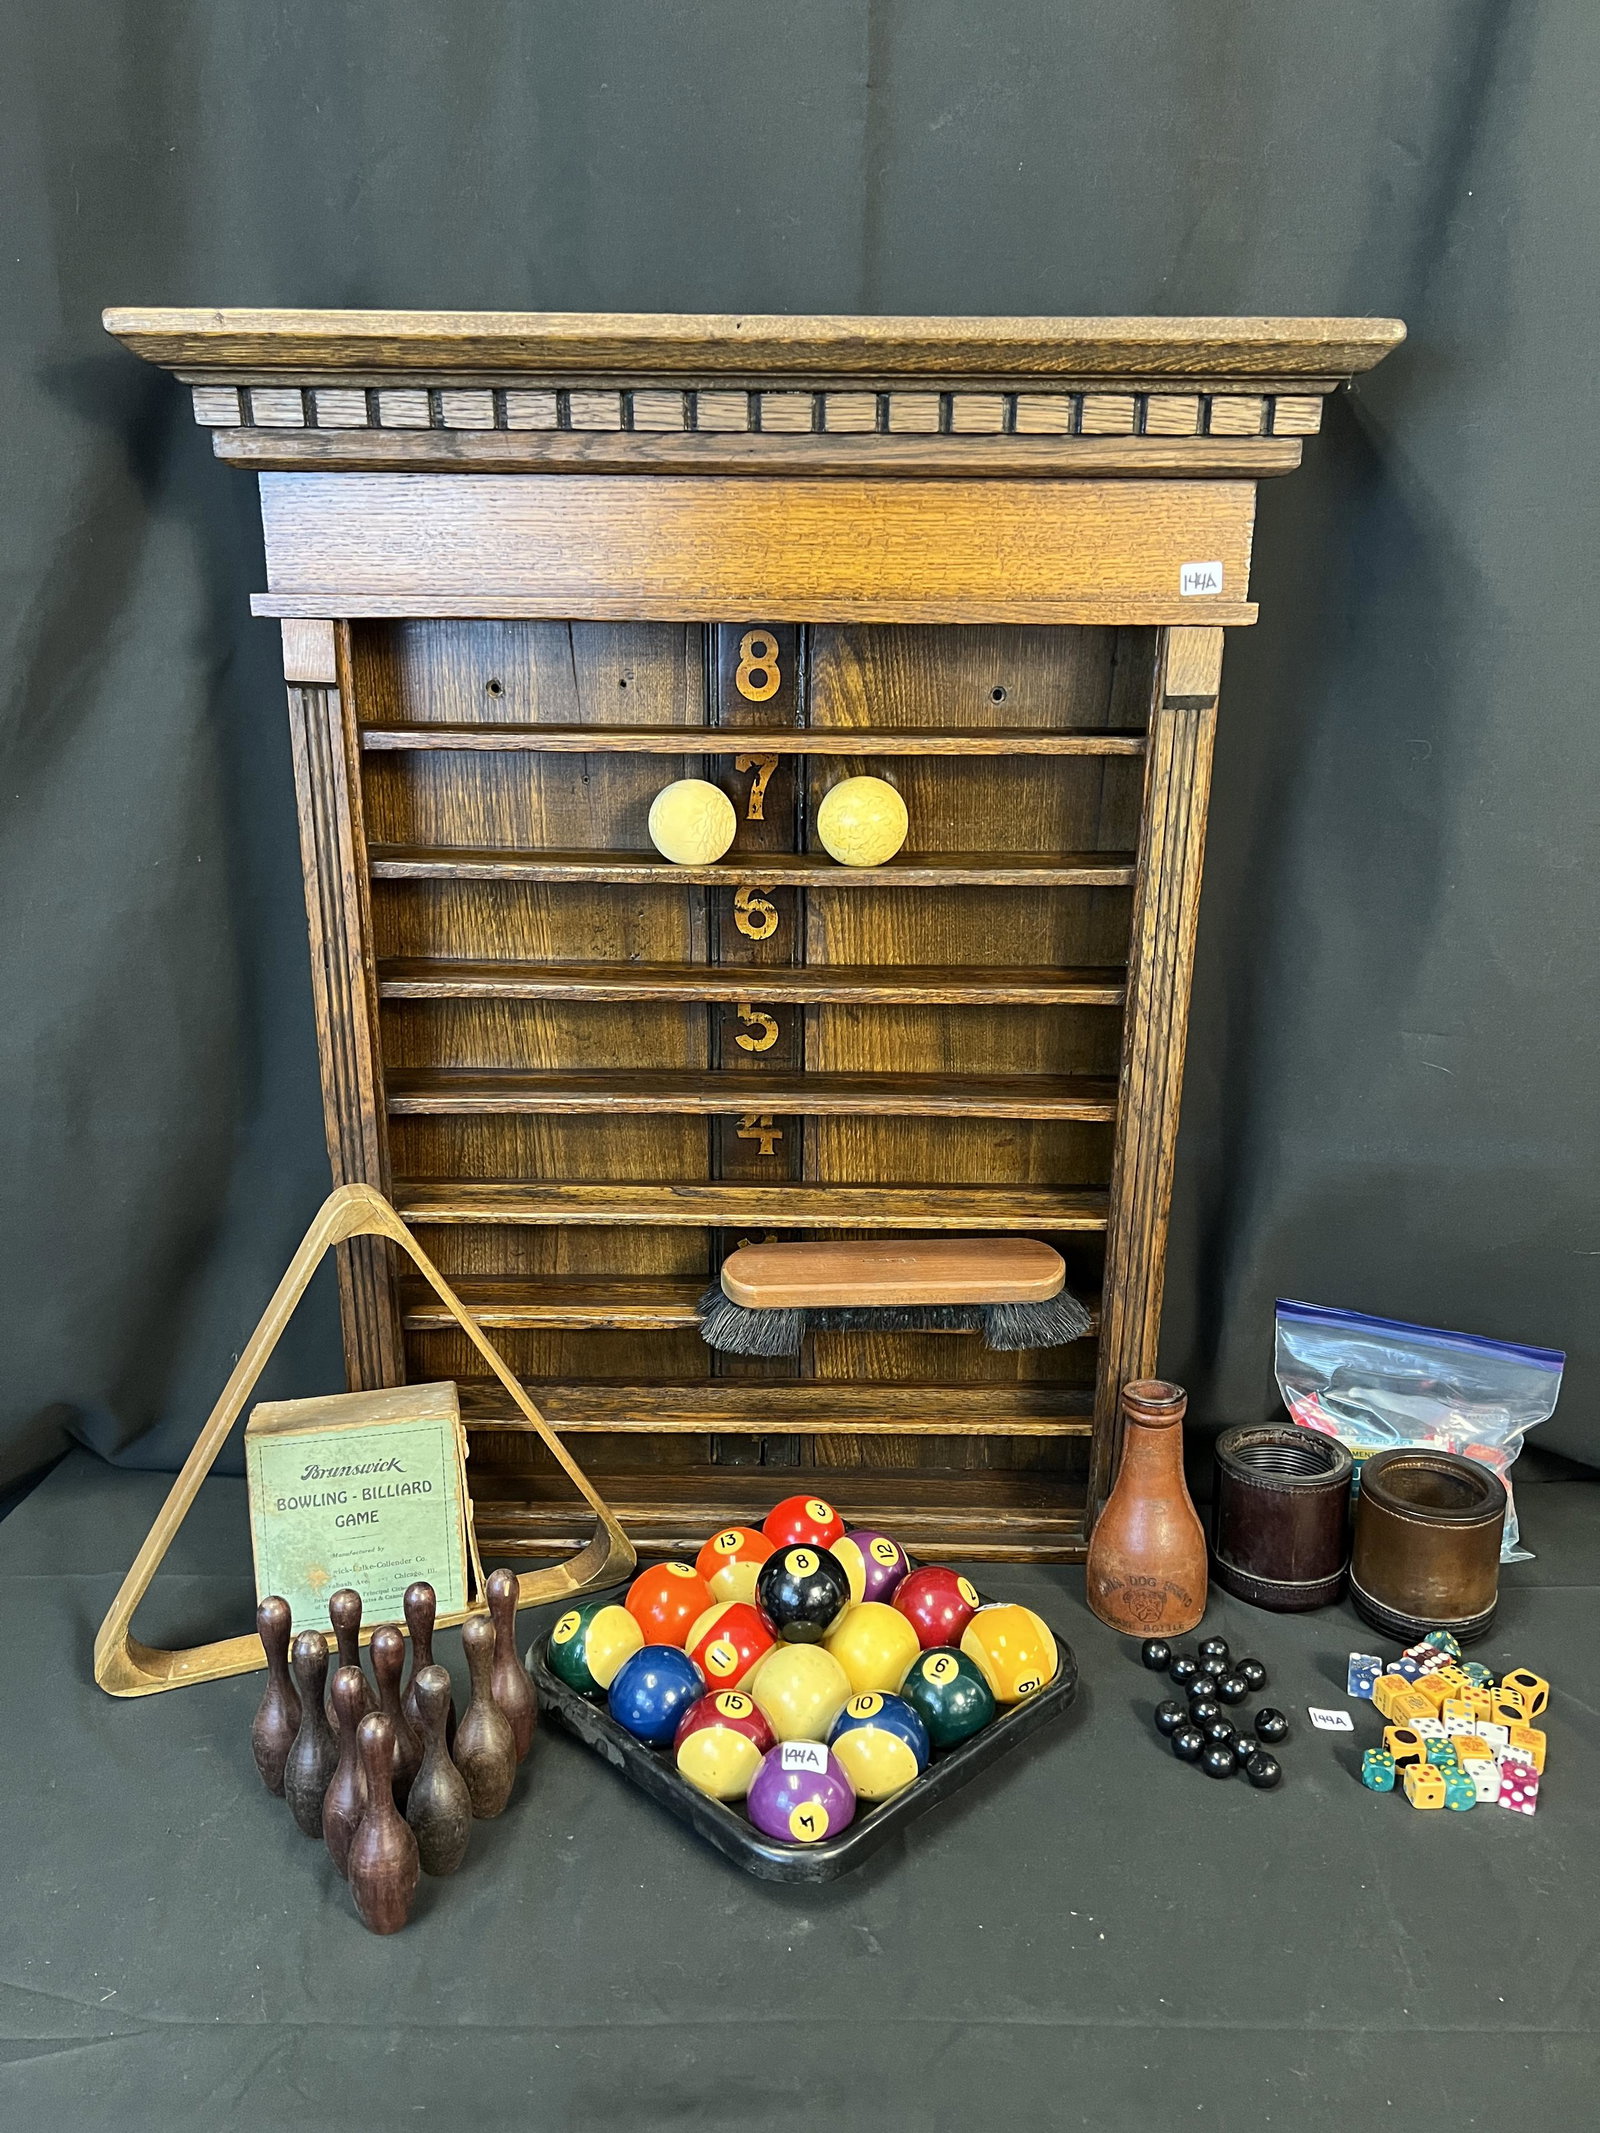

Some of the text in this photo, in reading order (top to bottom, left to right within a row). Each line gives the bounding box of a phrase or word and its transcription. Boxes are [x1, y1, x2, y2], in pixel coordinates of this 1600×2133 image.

[1184, 572, 1217, 592] 144A
[735, 629, 782, 702] 8
[735, 753, 779, 820] 7
[734, 886, 779, 941] 6
[735, 1003, 779, 1051] 5
[735, 1115, 783, 1155] 4
[300, 1457, 407, 1481] Brunswick
[276, 1490, 348, 1511] BOWLING
[361, 1480, 432, 1501] BILLIARD
[335, 1510, 380, 1528] GAME
[814, 1504, 827, 1517] 3
[720, 1533, 737, 1548] 13
[331, 1548, 376, 1558] Manufactured
[876, 1543, 894, 1559] 12
[674, 1563, 689, 1572] 5
[795, 1554, 809, 1569] 8
[1129, 1575, 1157, 1587] DOG
[558, 1617, 576, 1634] 14
[711, 1648, 732, 1669] 11
[931, 1658, 949, 1676] 6
[724, 1694, 745, 1710] 15
[855, 1696, 873, 1711] 10
[785, 1748, 820, 1766] 144A
[799, 1815, 815, 1832] 4
